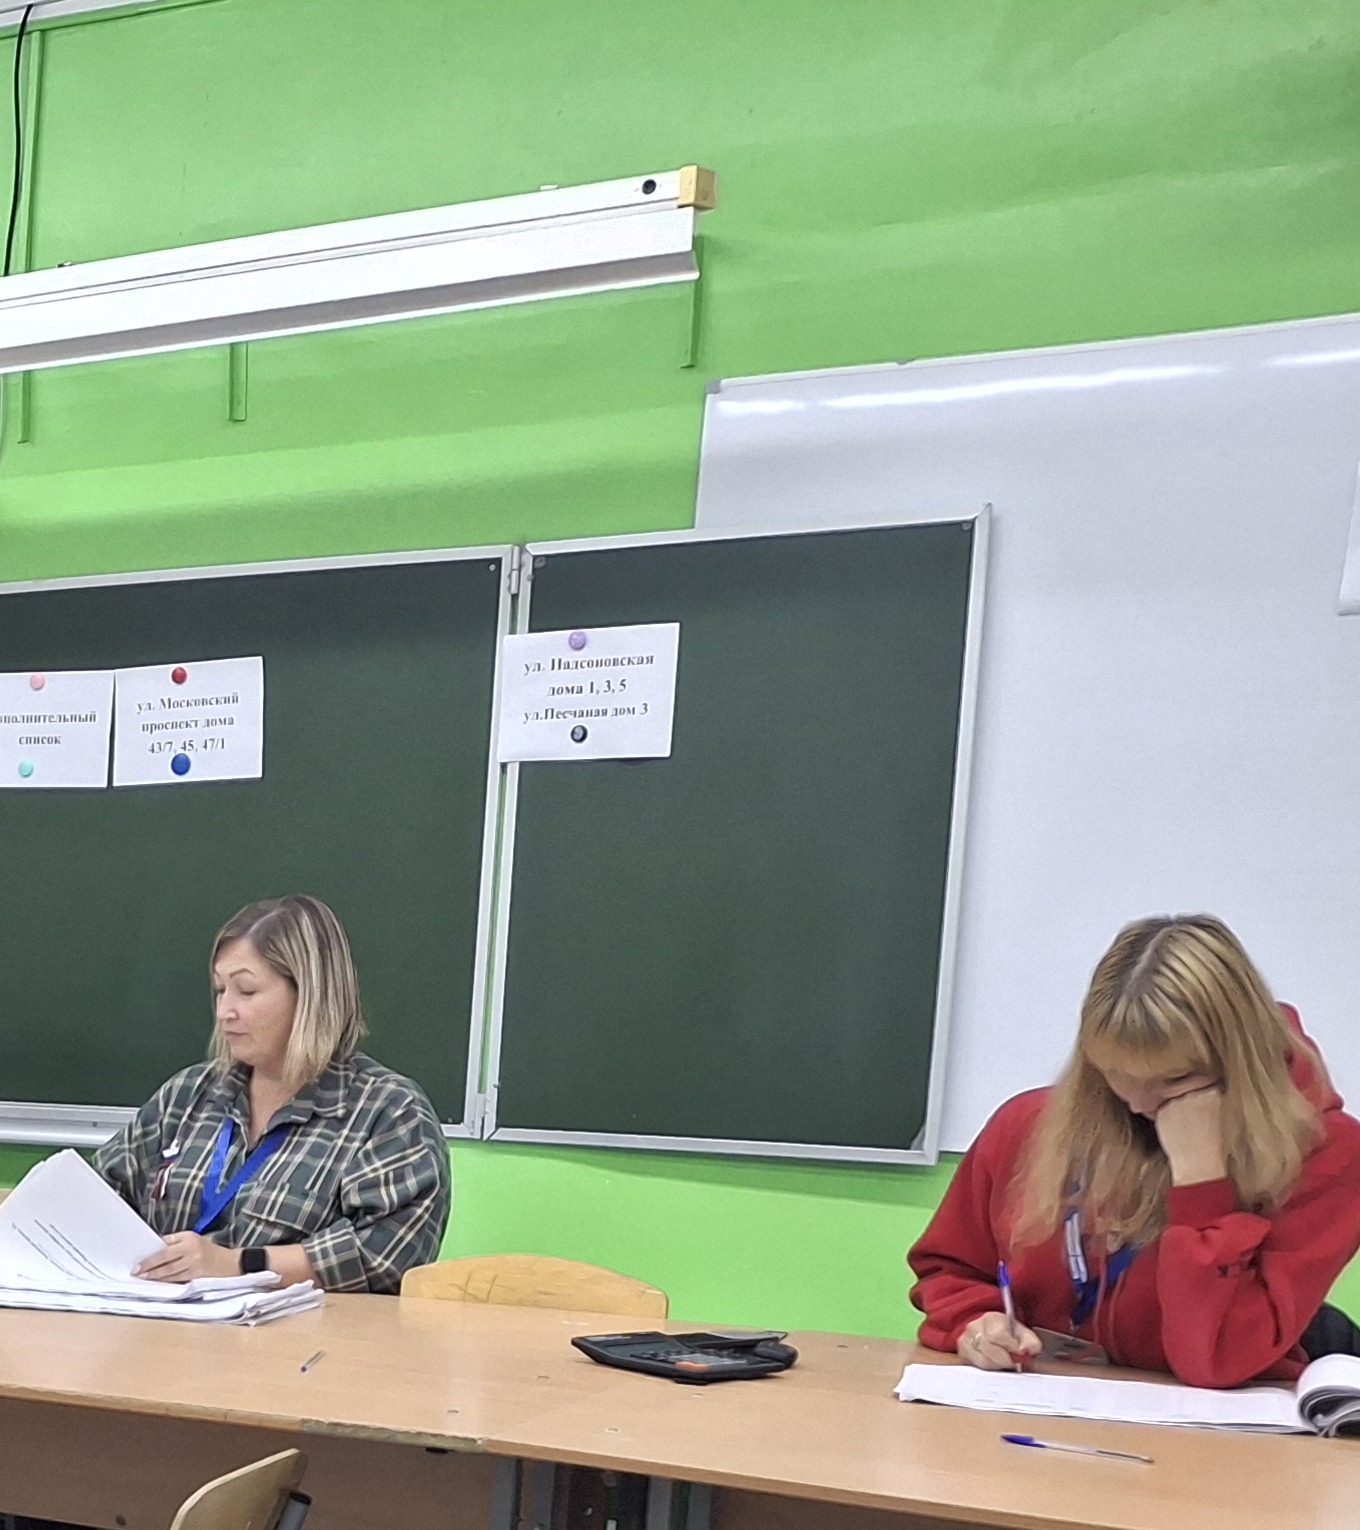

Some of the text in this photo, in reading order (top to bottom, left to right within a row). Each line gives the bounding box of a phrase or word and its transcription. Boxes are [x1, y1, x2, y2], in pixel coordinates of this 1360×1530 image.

[523, 654, 654, 676] ул. Надсоновская
[548, 678, 627, 697] дома 1, 3, 5
[136, 692, 239, 715] ул. Московский
[610, 705, 636, 717] дом
[639, 702, 649, 715] 3
[141, 716, 235, 735] проспект дома
[18, 735, 62, 745] список
[148, 738, 225, 755] 43/7, 45, 47/1
